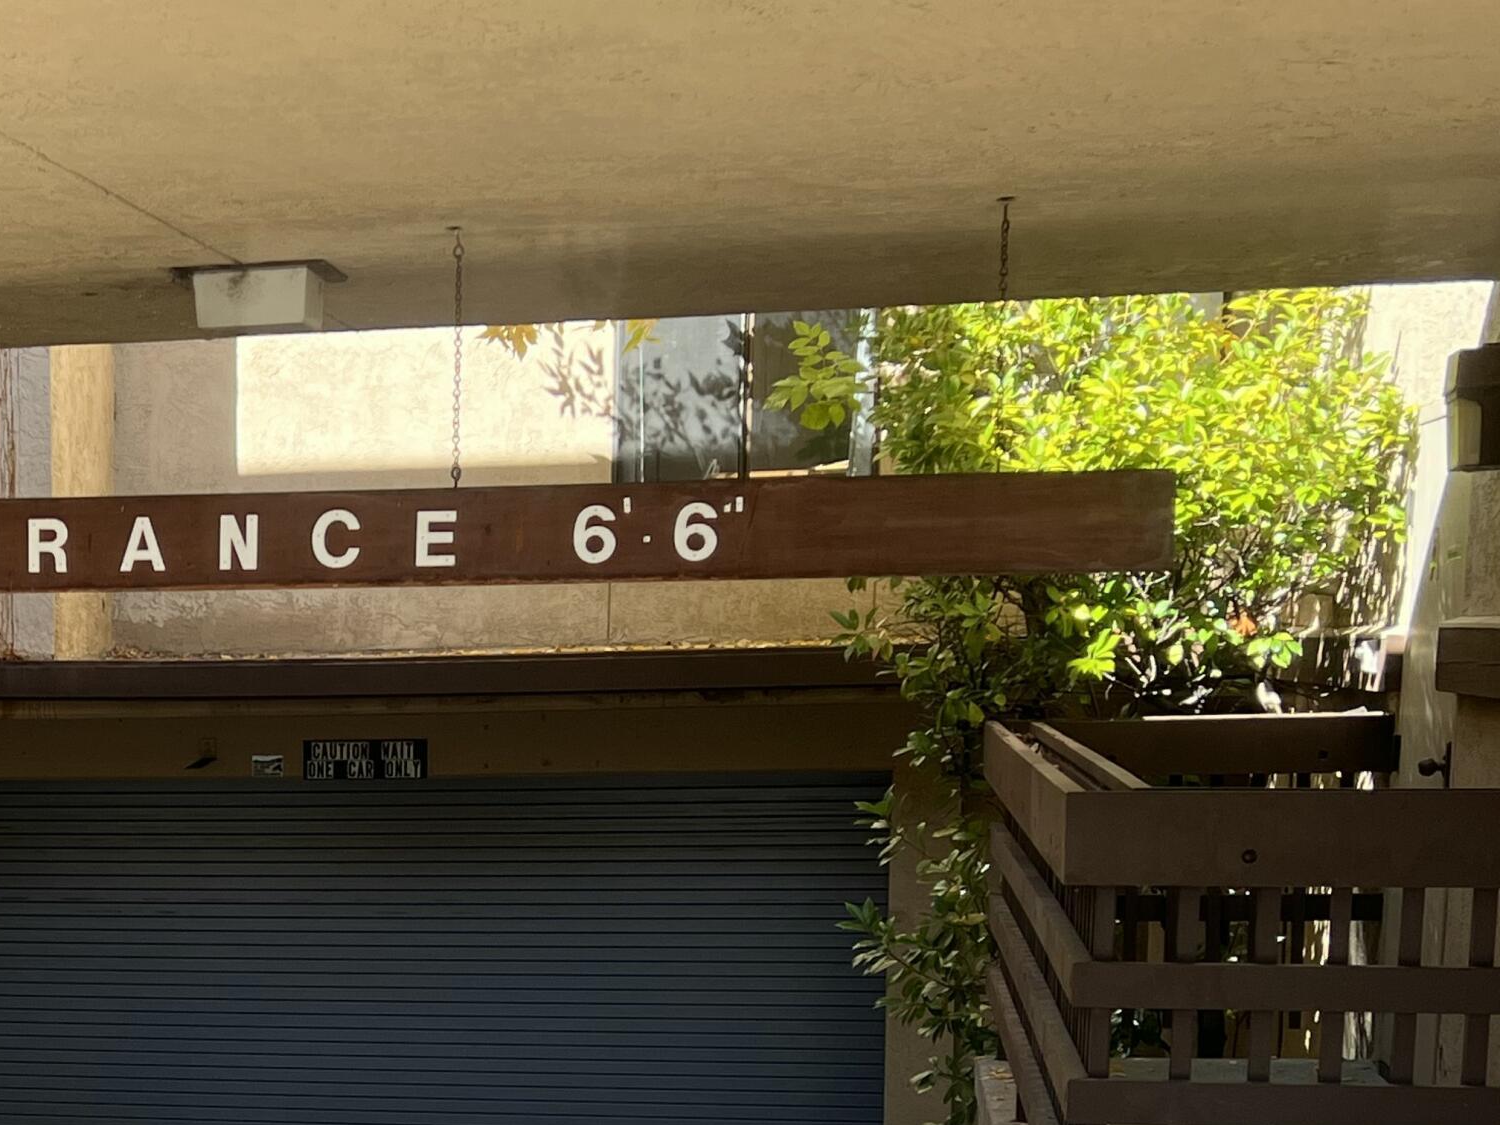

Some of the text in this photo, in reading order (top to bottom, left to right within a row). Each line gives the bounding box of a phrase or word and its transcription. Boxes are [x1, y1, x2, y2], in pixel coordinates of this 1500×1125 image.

[311, 742, 414, 760] CAUTION WAIT
[307, 760, 421, 778] ONE CAR ONLY
